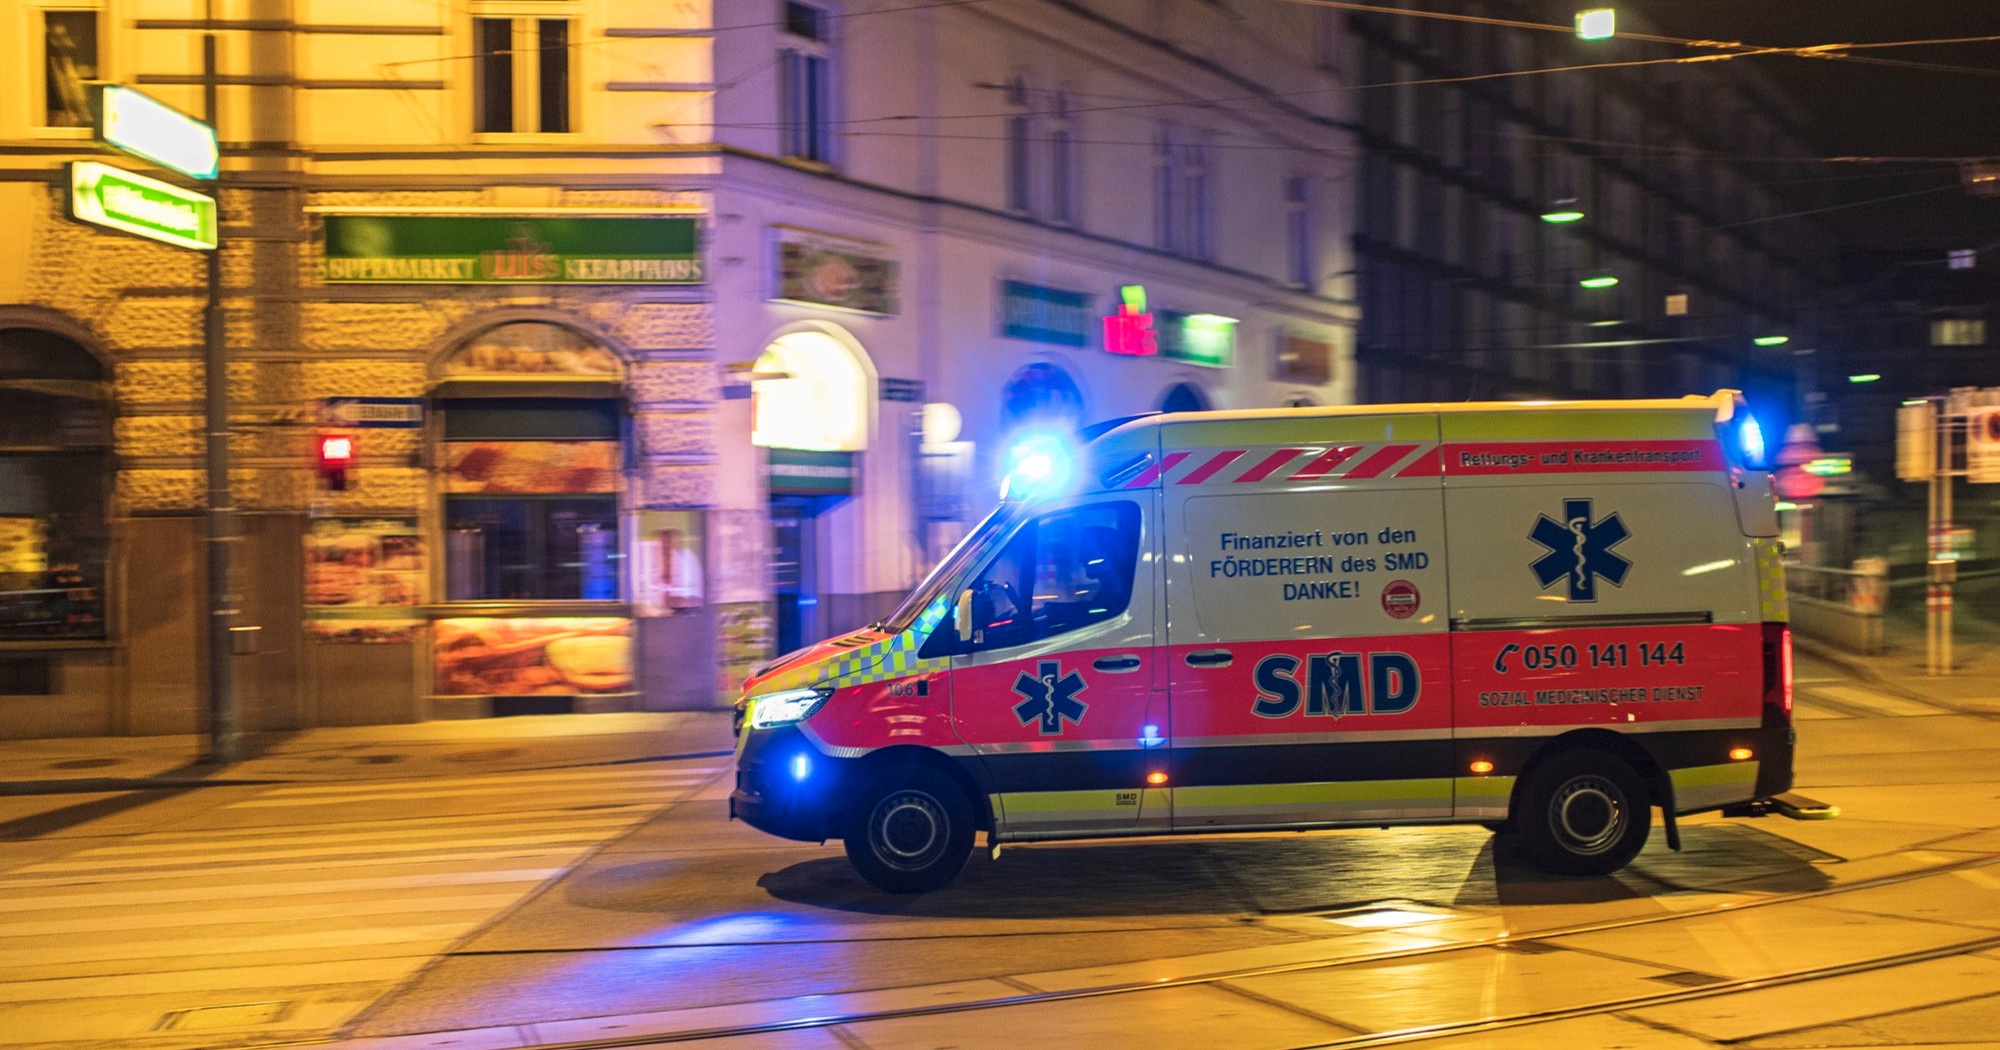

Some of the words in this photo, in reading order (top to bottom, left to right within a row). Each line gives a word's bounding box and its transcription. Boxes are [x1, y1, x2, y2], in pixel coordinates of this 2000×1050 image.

[1460, 451, 1536, 468] Rettungs-
[1540, 450, 1568, 465] und
[1572, 448, 1702, 465] Krankentransport
[1220, 529, 1323, 550] Finanziert
[1331, 531, 1369, 546] von
[1377, 527, 1417, 545] den
[1210, 555, 1334, 579] FÖRDERERN
[1340, 555, 1377, 574] des
[1383, 551, 1430, 571] SMD
[1283, 580, 1361, 601] DANKE!
[1523, 644, 1578, 670] 050
[1588, 642, 1628, 668] 141
[1638, 641, 1686, 667] 144
[1250, 650, 1422, 719] SMD
[1479, 690, 1532, 707] SOZIAL
[1535, 688, 1648, 705] MEDIZINISCHER
[1652, 686, 1704, 702] DIENST
[1116, 793, 1137, 801] SMD
